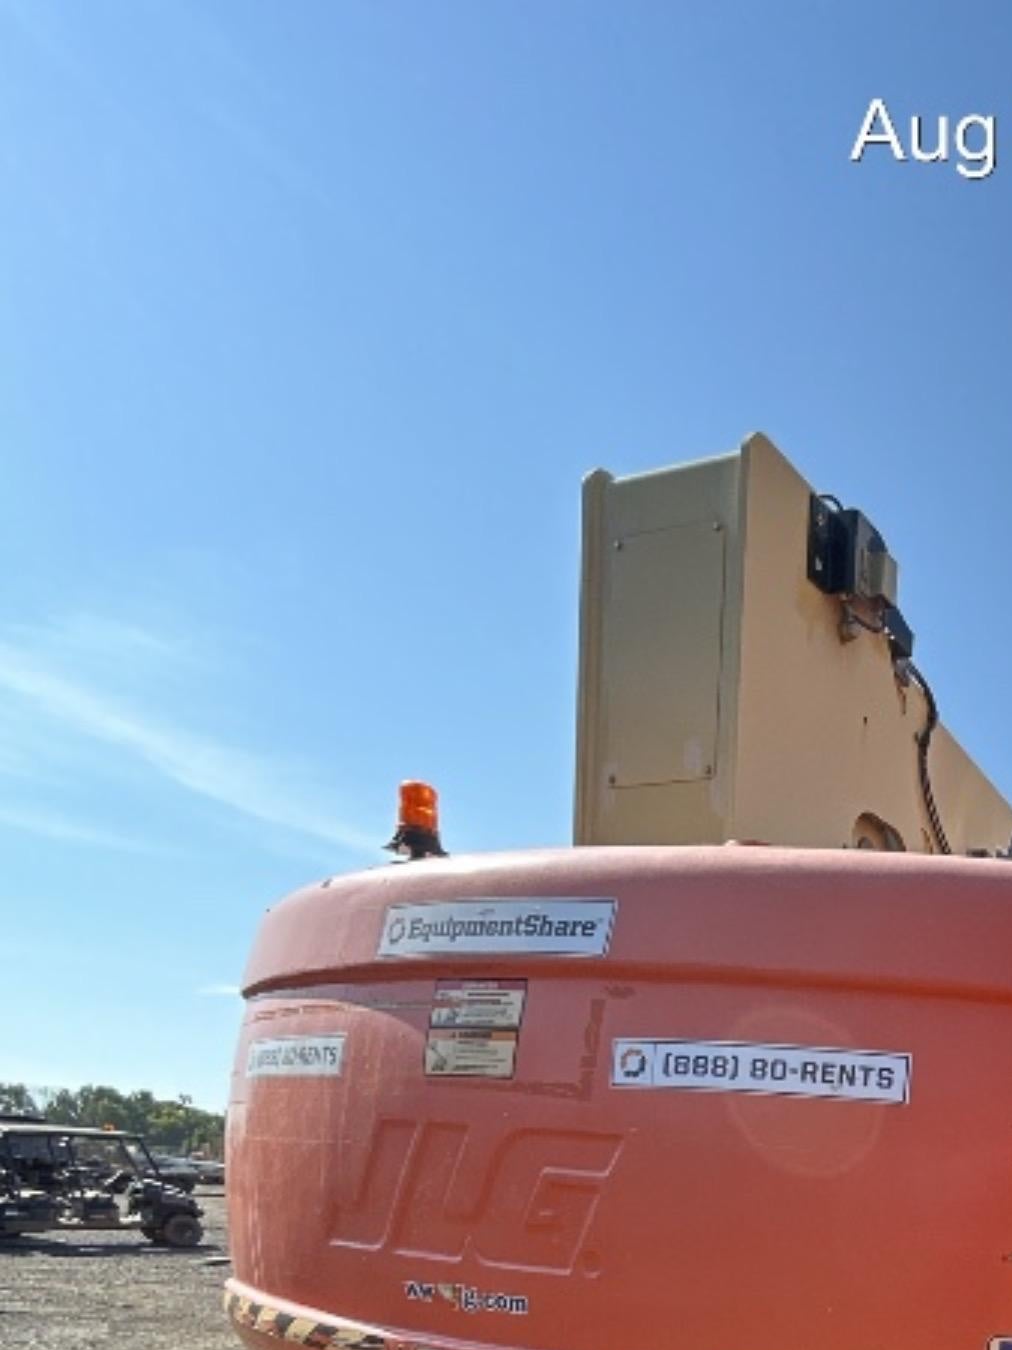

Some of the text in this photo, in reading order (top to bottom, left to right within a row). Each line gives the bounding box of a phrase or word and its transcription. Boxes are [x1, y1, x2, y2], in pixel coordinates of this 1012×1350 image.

[407, 914, 599, 942] EquipmentShare
[662, 1053, 895, 1090] (888) 80-RENTS
